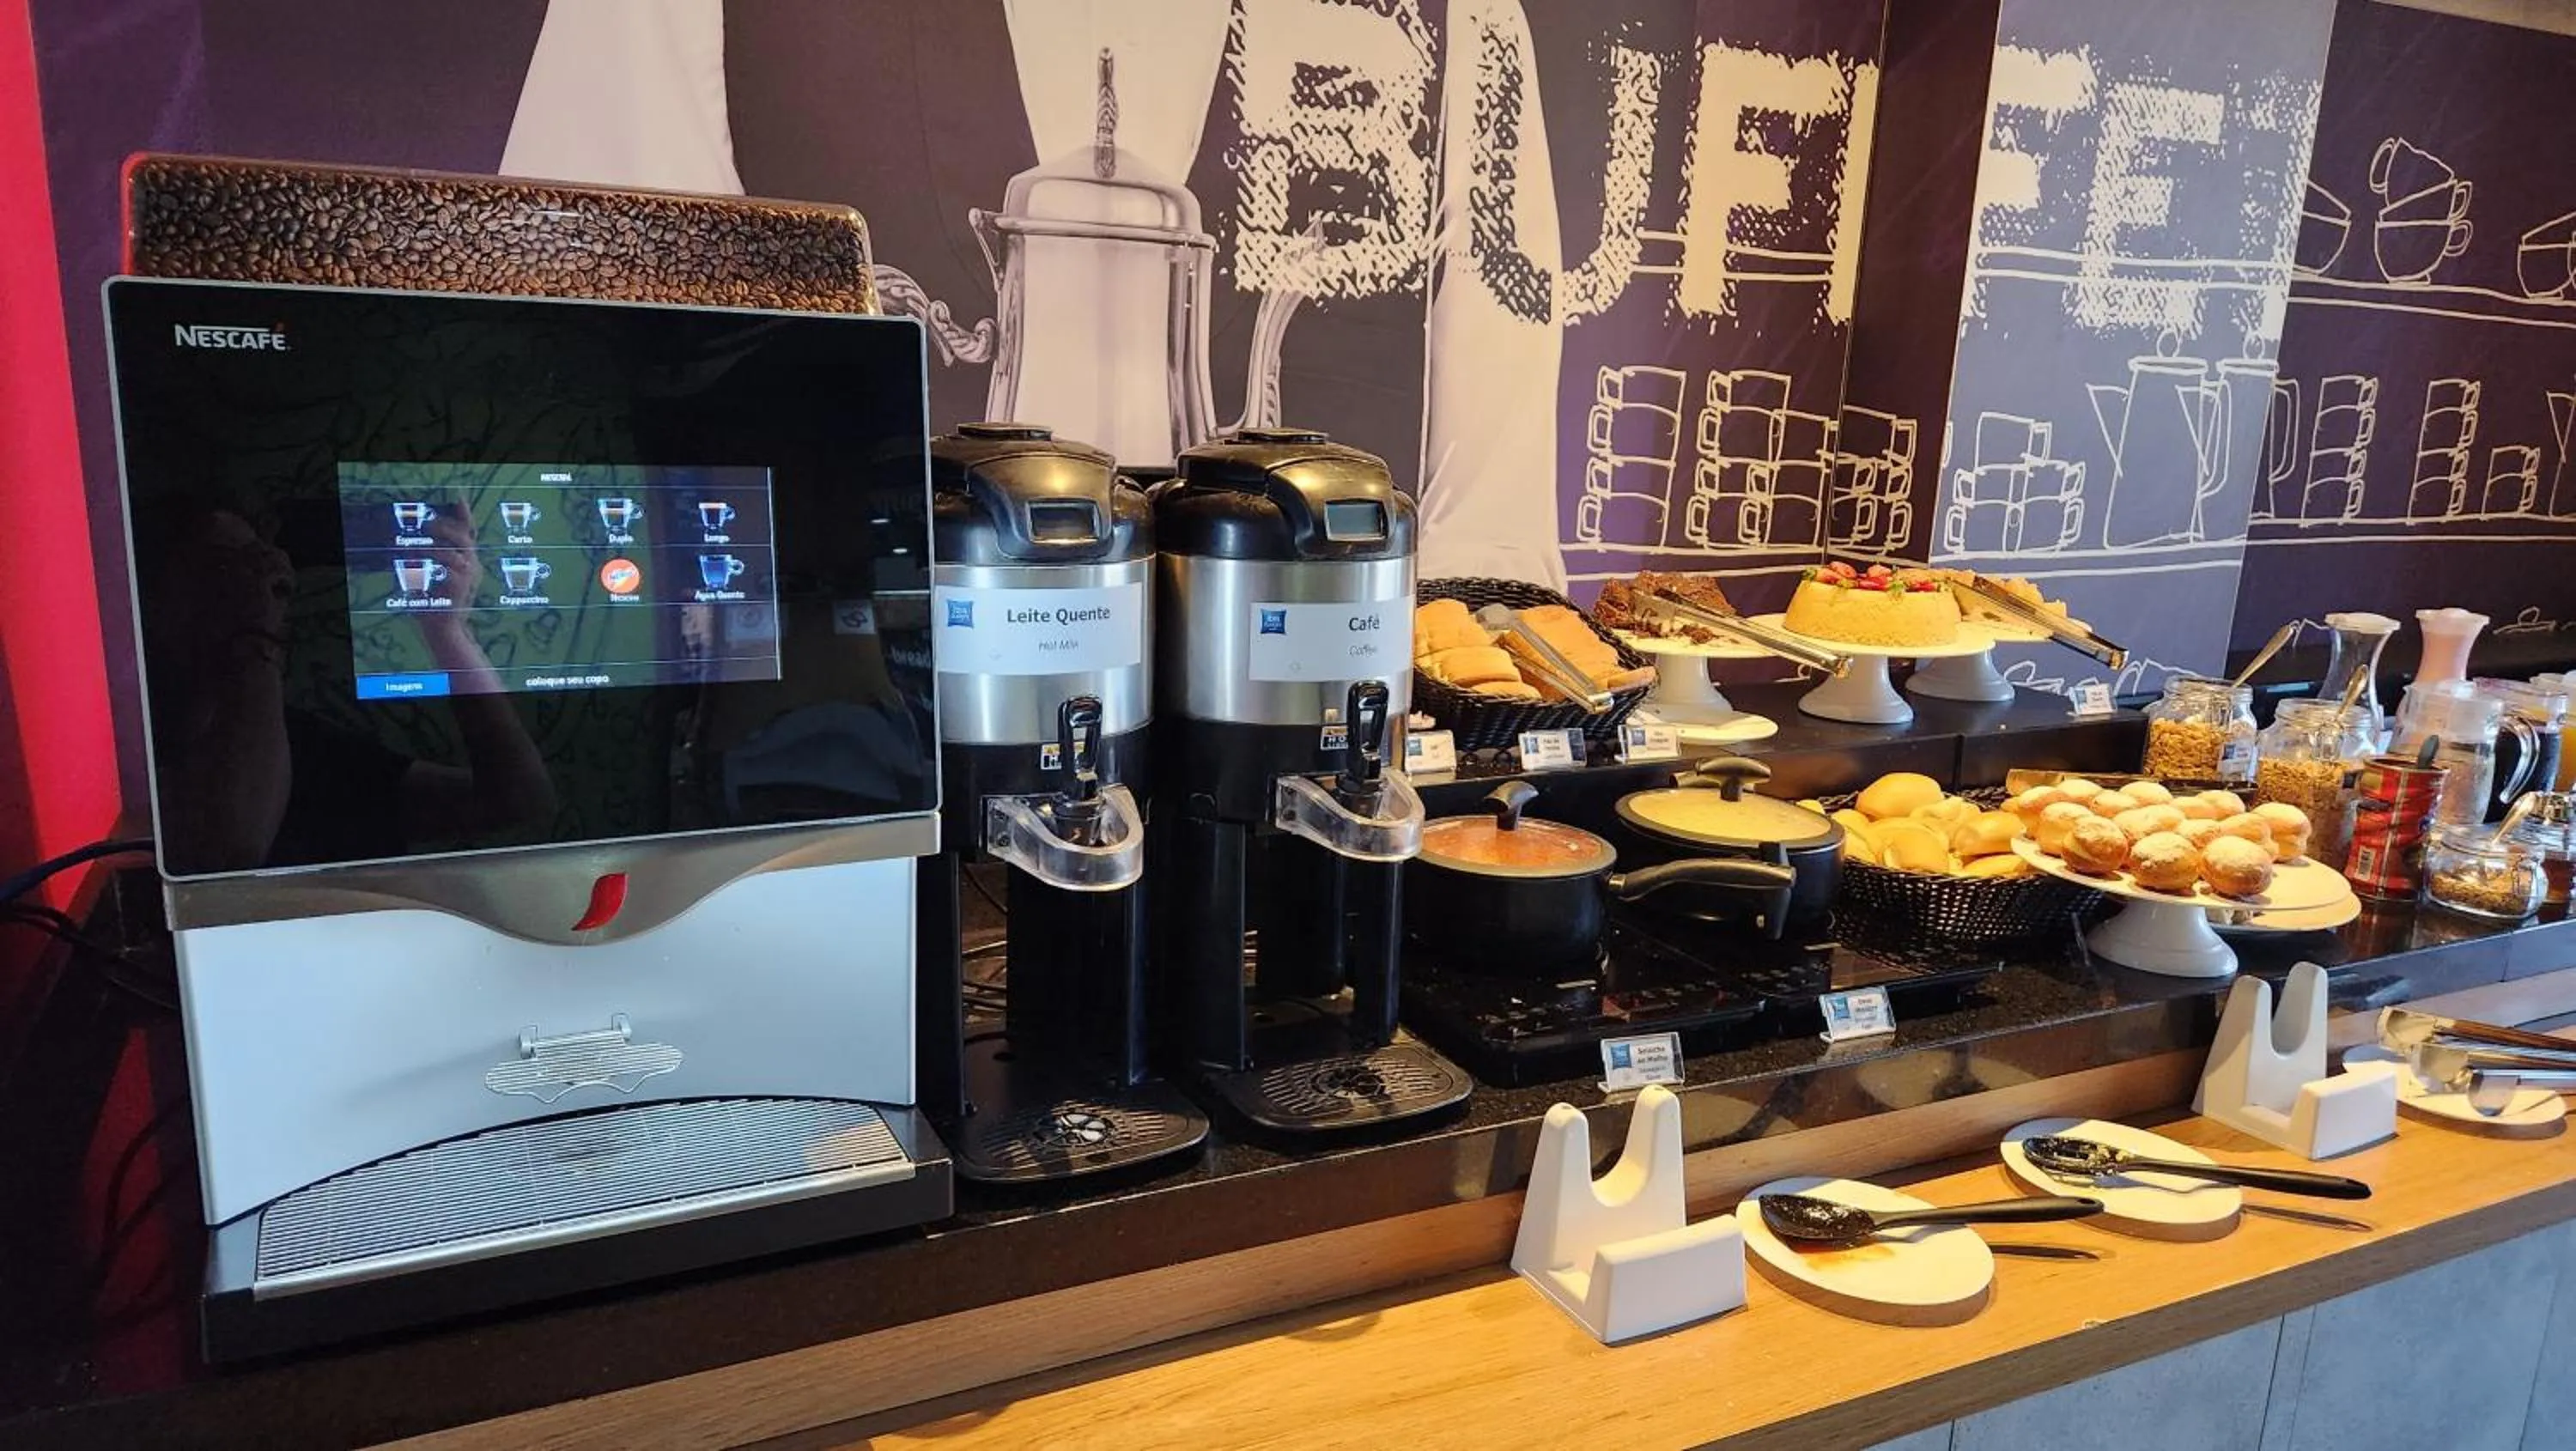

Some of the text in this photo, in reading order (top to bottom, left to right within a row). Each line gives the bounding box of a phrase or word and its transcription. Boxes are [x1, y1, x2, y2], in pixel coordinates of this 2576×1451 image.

[1007, 606, 1111, 626] Leite Quente
[1348, 614, 1381, 632] Café
